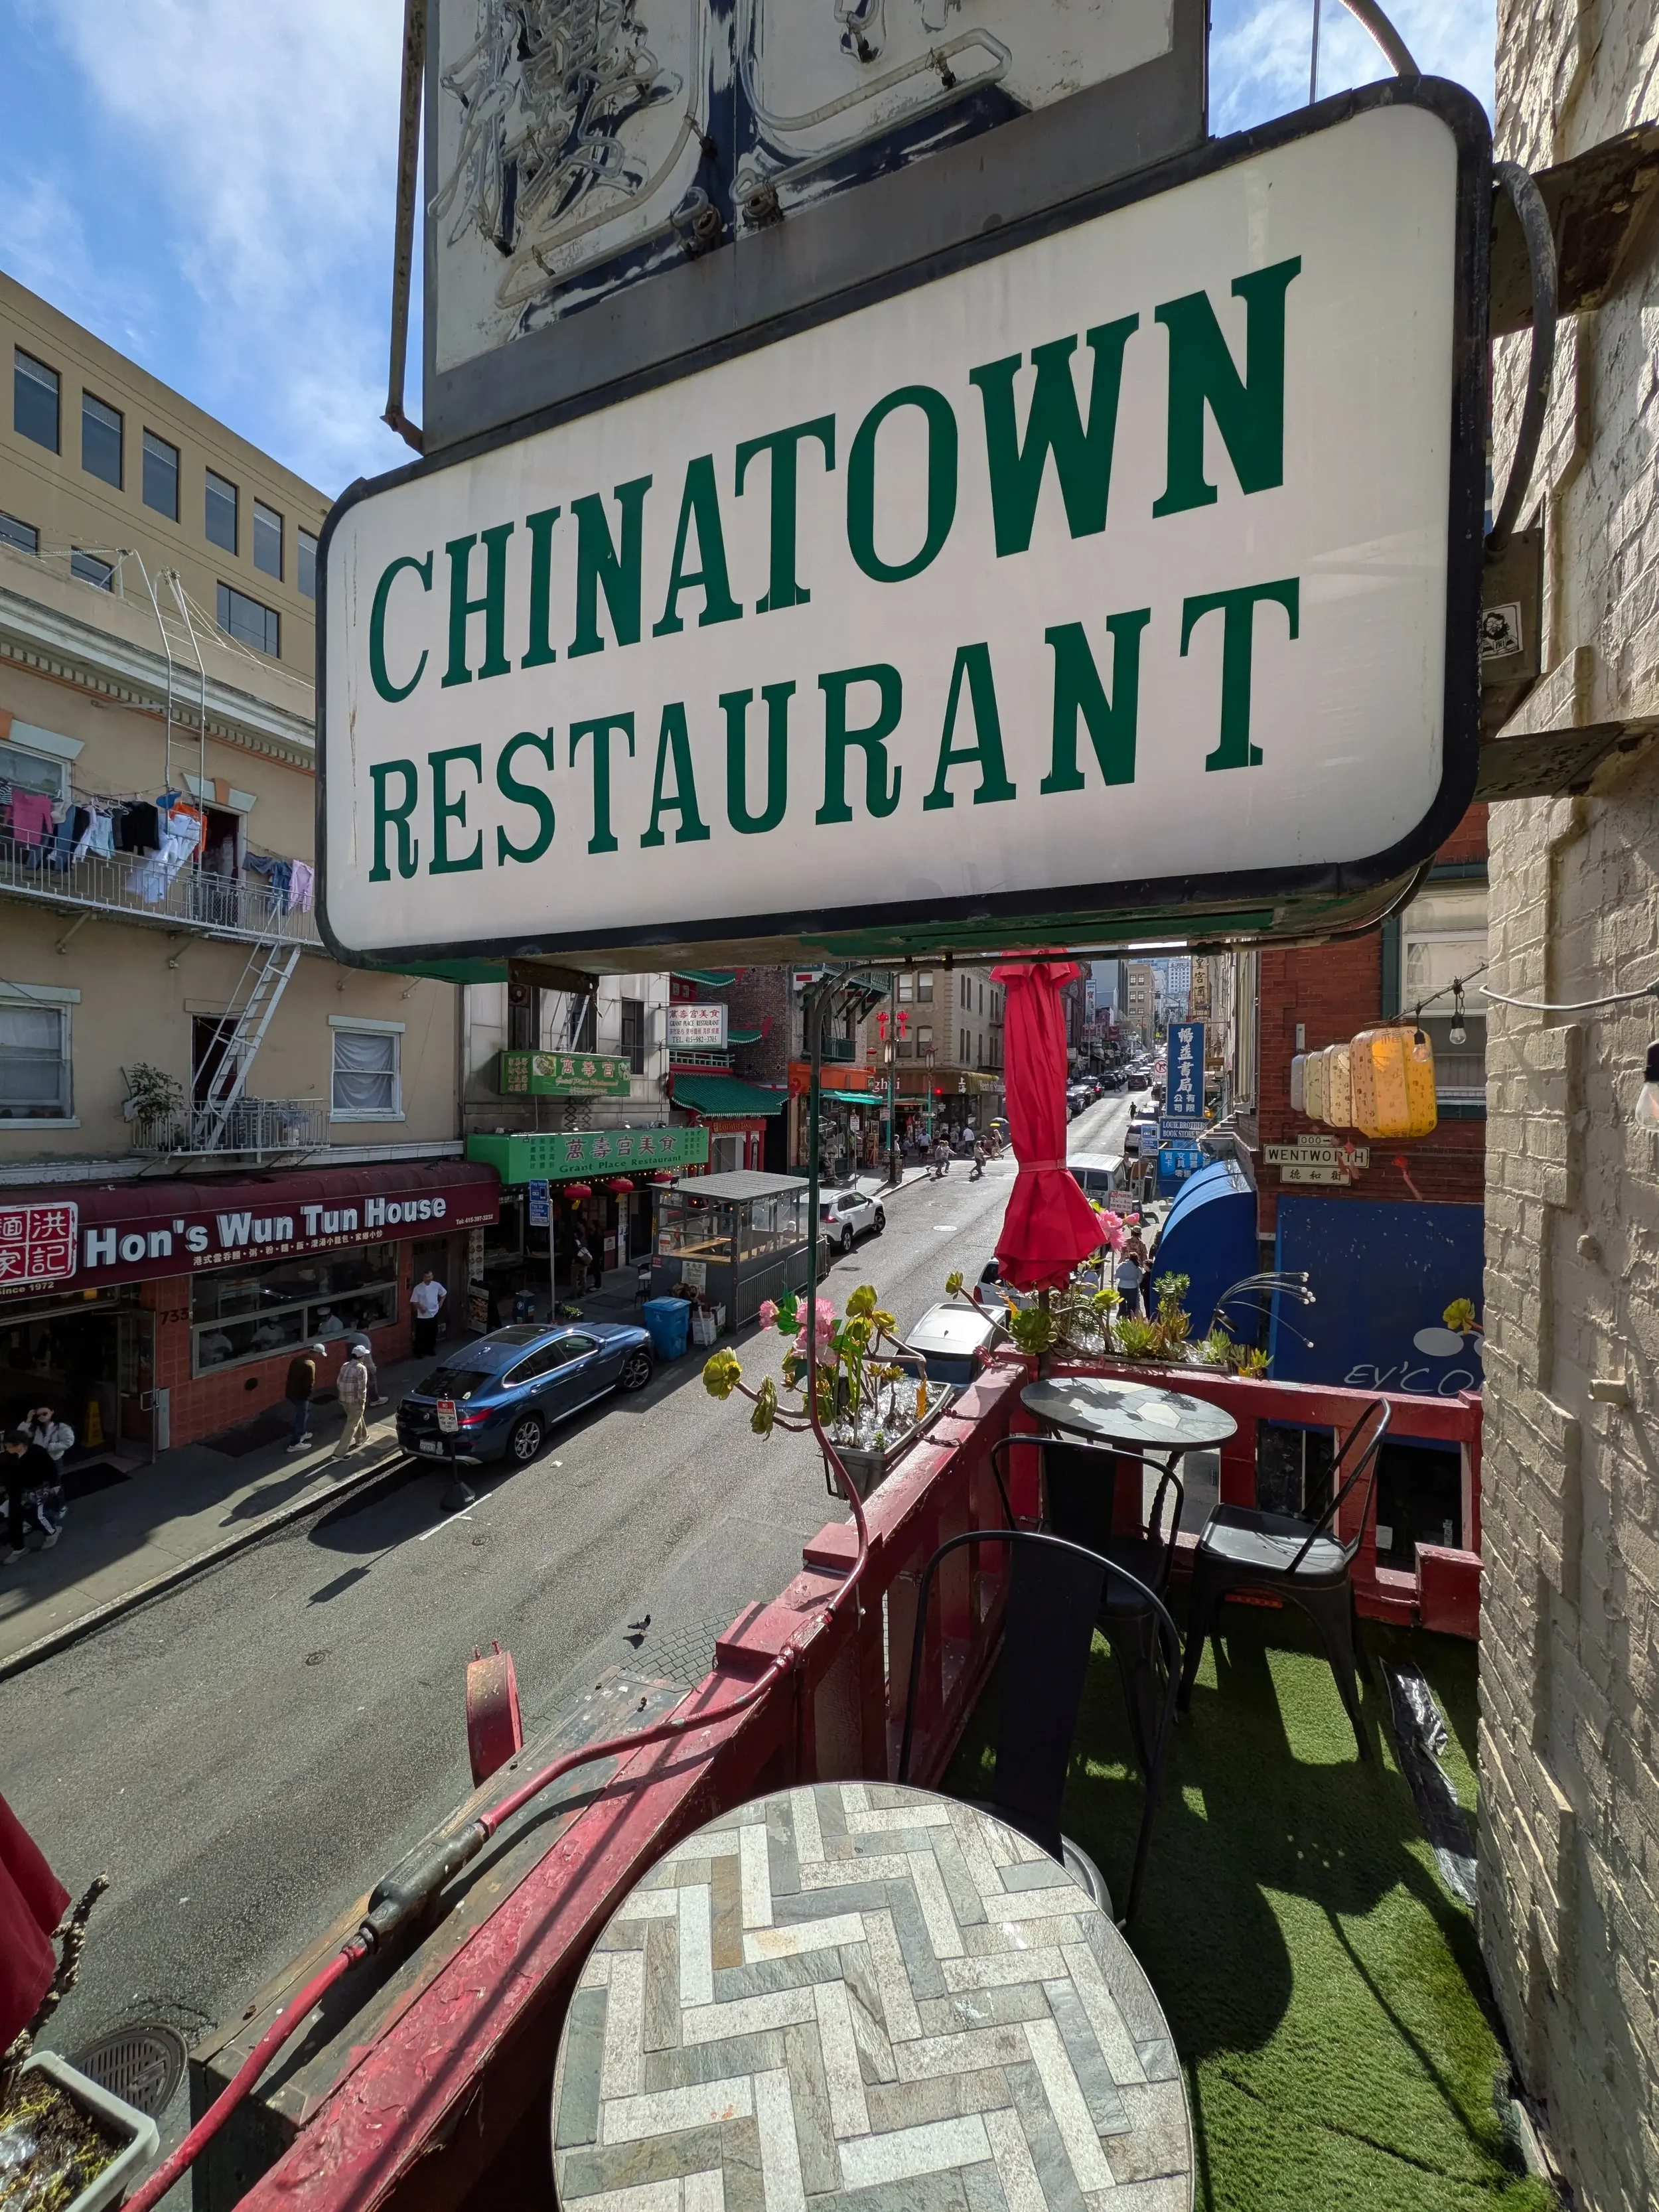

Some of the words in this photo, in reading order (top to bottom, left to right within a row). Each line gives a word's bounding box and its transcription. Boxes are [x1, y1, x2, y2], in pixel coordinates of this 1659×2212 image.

[369, 255, 1301, 703] CHINATOWN
[369, 577, 1299, 884] RESTAURANT
[1194, 958, 1205, 1004] 皇宮酒
[560, 1056, 616, 1078] 萬壽宮
[1174, 1094, 1183, 1112] 公司
[565, 1134, 678, 1162] 萬壽宮美食
[559, 1163, 593, 1173] Grant
[599, 1160, 626, 1169] Place
[631, 1155, 681, 1166] Restaurant
[465, 1214, 494, 1223] 415-397-3232
[32, 1211, 68, 1274] 洪記
[84, 1220, 208, 1268] Hon's
[216, 1212, 293, 1248] Wun
[301, 1205, 358, 1236] Tun
[364, 1197, 447, 1228] House
[29, 1282, 54, 1291] 1972
[160, 1307, 189, 1325] 733
